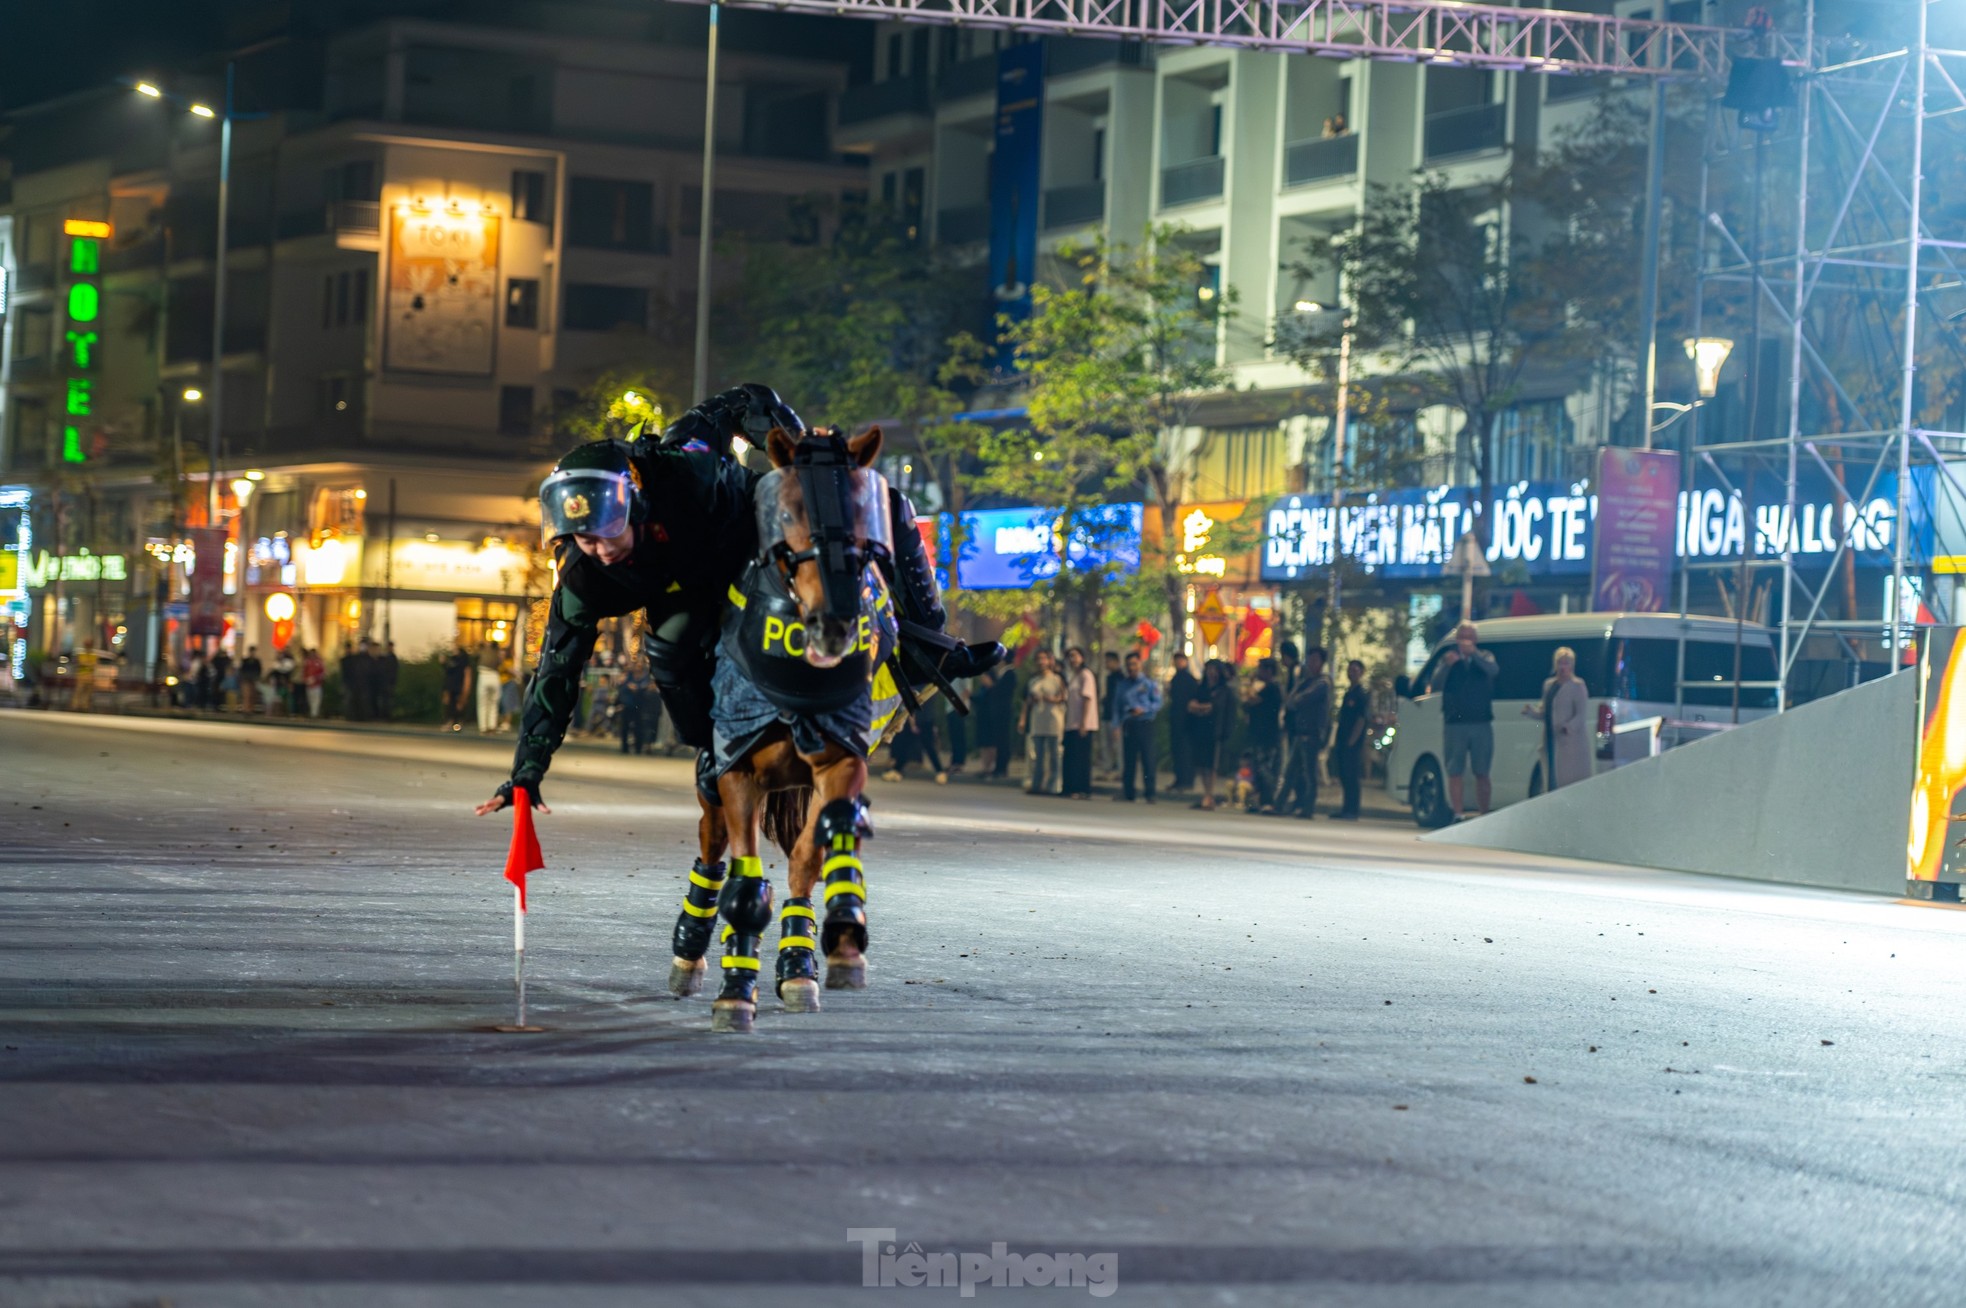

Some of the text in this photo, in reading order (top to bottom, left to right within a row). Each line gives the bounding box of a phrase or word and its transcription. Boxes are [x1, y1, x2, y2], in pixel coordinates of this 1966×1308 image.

[62, 238, 99, 464] HOTEL
[1266, 496, 1336, 578] BỆNH
[1339, 493, 1398, 575] VIỆN
[1401, 484, 1460, 564] MẮT
[1461, 480, 1544, 562] ỐC
[1547, 478, 1589, 560] TẾ
[1676, 488, 1745, 557] NGA
[762, 615, 871, 657] POE
